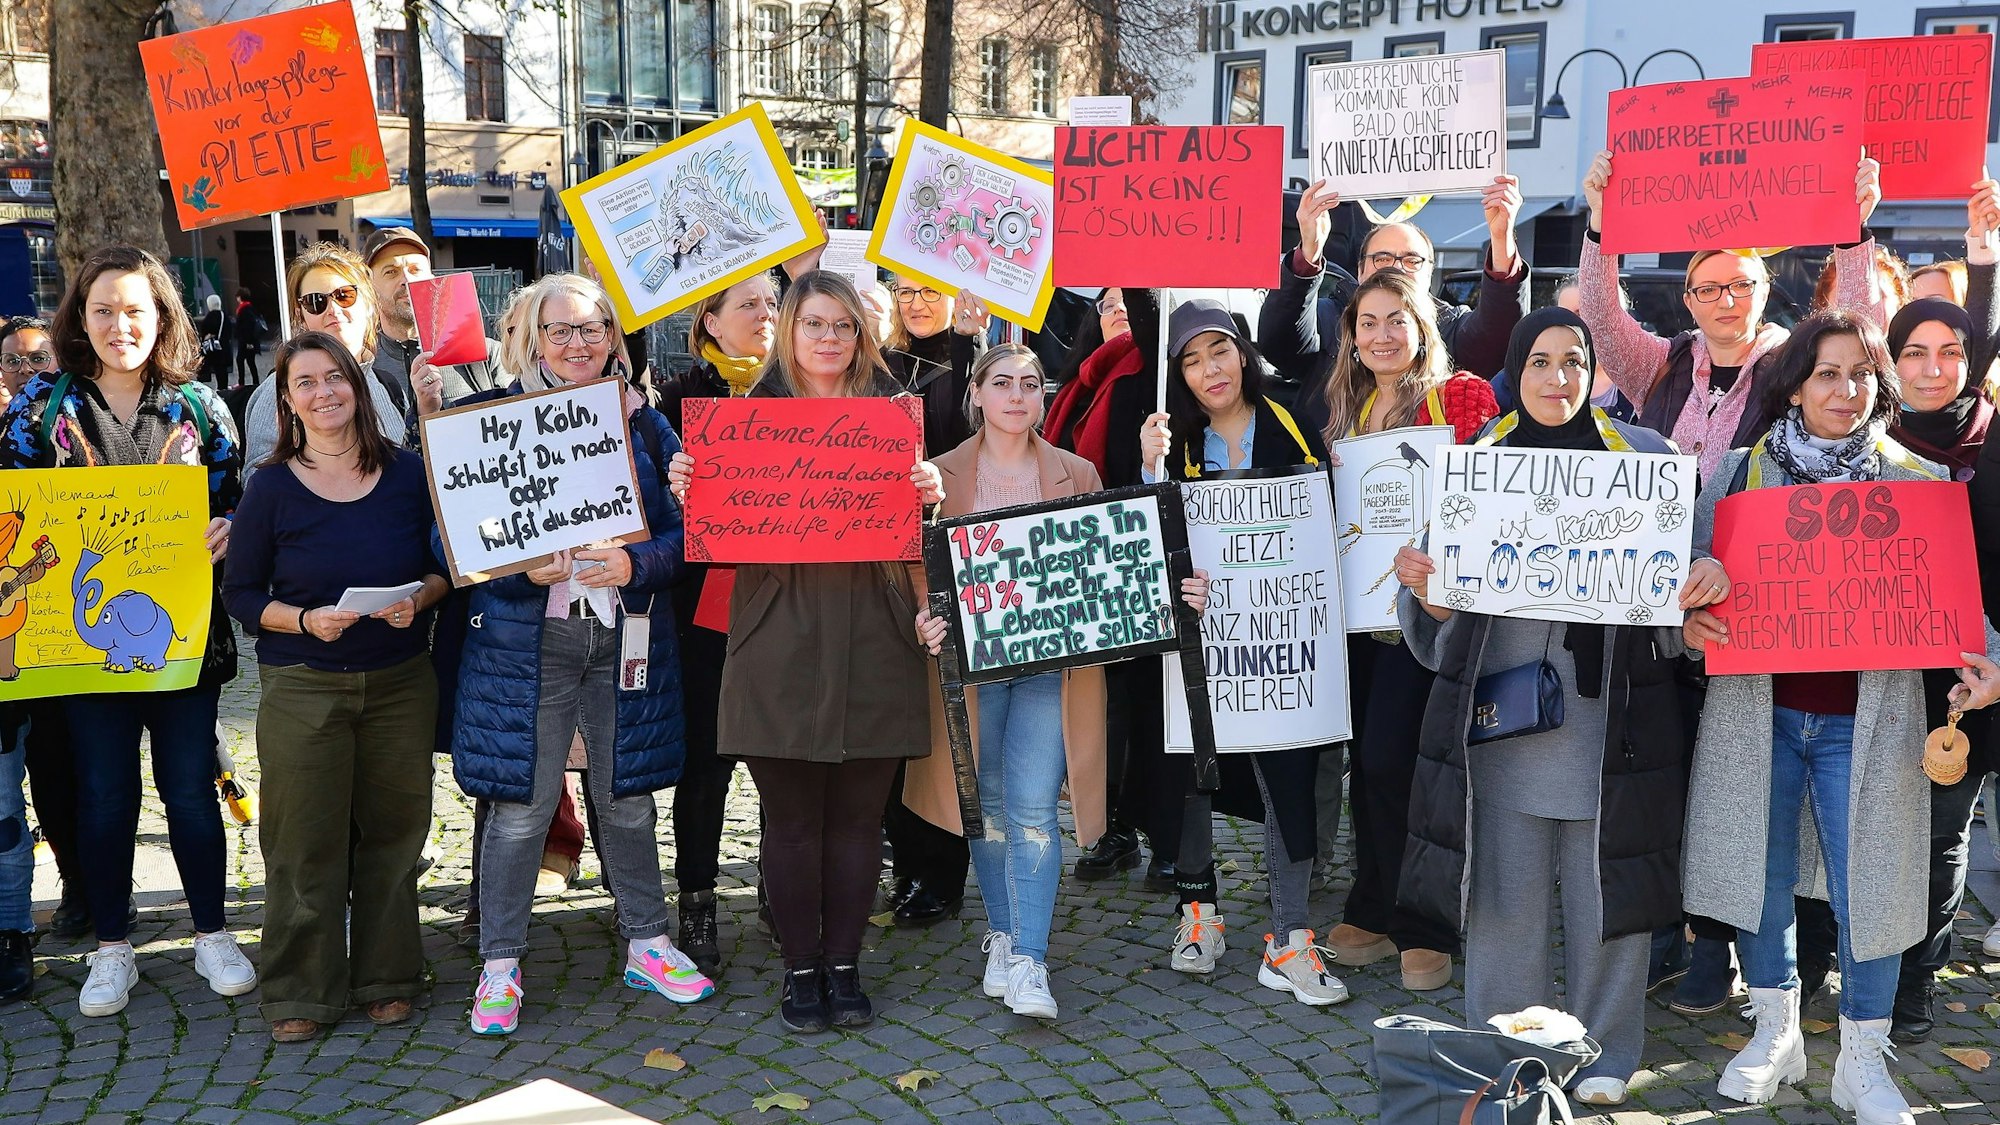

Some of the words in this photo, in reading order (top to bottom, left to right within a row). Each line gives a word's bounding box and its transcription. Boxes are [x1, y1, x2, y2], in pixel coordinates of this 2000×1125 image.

[1242, 0, 1399, 37] KONCEPT
[1416, 0, 1563, 21] HOT
[158, 49, 347, 115] Kindertagespflege
[1323, 58, 1463, 92] KINDERFREUNLICHE
[1335, 88, 1409, 113] KOMMUNE
[1422, 83, 1459, 107] KÖLN
[1615, 95, 1640, 116] MEHR
[1751, 74, 1792, 91] MEHR
[1807, 85, 1853, 100] MEHR
[1864, 80, 1974, 122] GESPFLEGE
[214, 113, 242, 134] vor
[260, 100, 293, 125] der
[1353, 113, 1396, 137] BALD
[1403, 108, 1447, 135] OHNE
[1613, 115, 1826, 153] KINDERBETREUUNG
[200, 119, 337, 187] PLEITE
[1178, 126, 1252, 163] AUS
[1321, 129, 1497, 177] KINDERTAGESPFLEGE?
[1699, 148, 1748, 167] KEIN
[1866, 138, 1928, 165] ELFEN
[600, 197, 615, 208] Eine
[615, 188, 636, 201] Aktion
[1059, 175, 1106, 203] IST
[1621, 163, 1837, 207] PERSONALMANGEL
[1687, 200, 1759, 244] MEHR!
[680, 278, 698, 290] FELS
[700, 273, 707, 281] IN
[707, 264, 723, 277] DER
[723, 248, 758, 269] BRANDUNG
[1003, 263, 1022, 274] Aktion
[480, 415, 523, 451] Hey
[534, 399, 598, 436] Köln,
[443, 449, 527, 490] Schläfst
[533, 444, 566, 469] Du
[695, 455, 785, 482] Sonne,
[854, 466, 911, 483] aber
[1445, 451, 1594, 498] HEIZUNG
[1606, 458, 1679, 502] AUS
[37, 479, 118, 505] Niemand
[139, 479, 170, 497] will
[509, 475, 560, 508] oder
[1188, 481, 1311, 520] SOFORTHILFE
[1363, 494, 1411, 508] TAGESPFLEGE
[1365, 481, 1407, 495] KINDER-
[40, 511, 65, 528] die
[478, 508, 540, 552] hilfst
[542, 509, 569, 533] du
[570, 485, 633, 527] schon?
[694, 514, 829, 543] Soforthilfe
[950, 522, 1005, 560] 1%
[1028, 514, 1101, 559] plus
[1106, 502, 1149, 535] in
[1498, 511, 1548, 541] ist
[1785, 485, 1900, 542] SOS
[956, 559, 999, 588] der
[997, 535, 1152, 585] Tagespflege
[1223, 530, 1294, 563] JETZT:
[1757, 541, 1826, 575] FRAU
[1842, 537, 1930, 573] REKER
[1249, 570, 1327, 608] UNSERE
[1443, 539, 1680, 608] LÖSUNG
[1734, 579, 1815, 613] BITTE
[1828, 574, 1933, 610] KOMMEN
[1250, 609, 1299, 642] NICHT
[1310, 603, 1328, 637] IM
[1871, 609, 1961, 647] FUNKEN
[972, 626, 1089, 672] Merkste
[1206, 639, 1316, 677] DUNKELN
